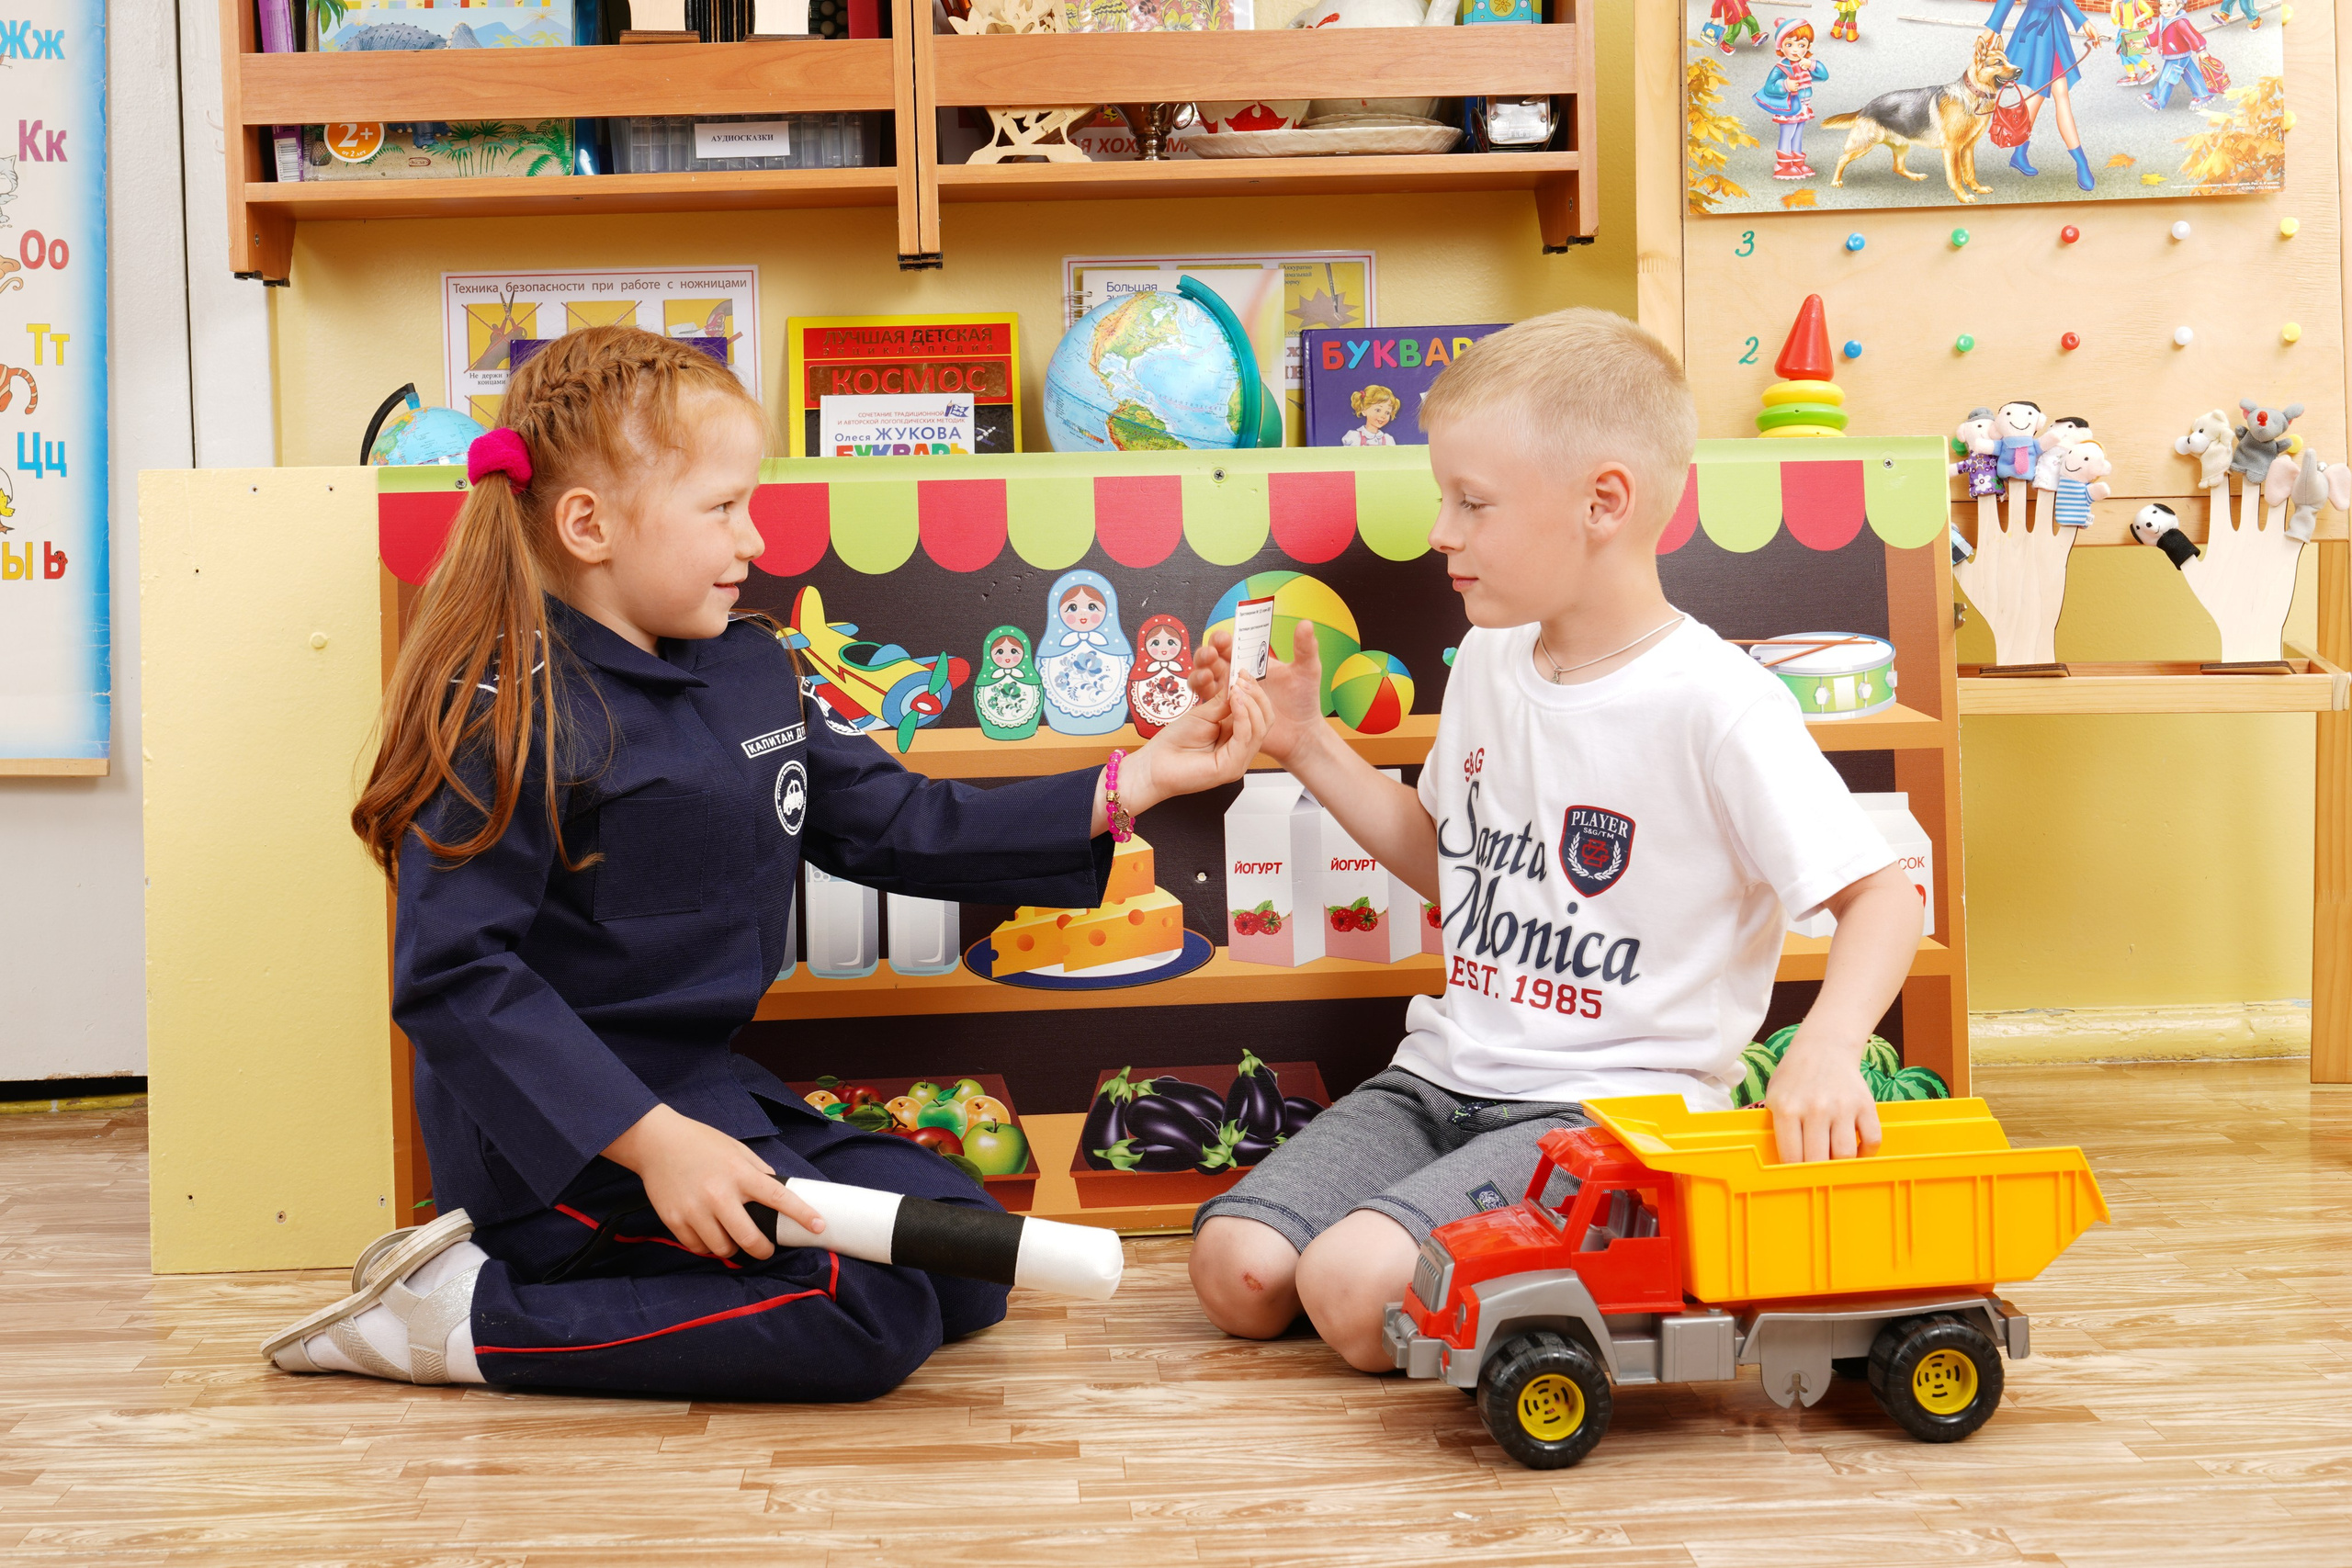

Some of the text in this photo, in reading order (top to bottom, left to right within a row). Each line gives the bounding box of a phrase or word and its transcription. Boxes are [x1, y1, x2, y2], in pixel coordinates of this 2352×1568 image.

[0, 20, 65, 60] Жж
[18, 119, 68, 162] Кк
[337, 123, 374, 148] 2+
[711, 134, 774, 142] АУДИОСКАЗКИ
[19, 229, 70, 270] Оо
[1735, 230, 1755, 257] 3
[453, 279, 747, 293] Техника безопасности при работе с ножницами
[1106, 281, 1158, 292] Большая
[26, 323, 71, 366] Тт
[823, 327, 992, 345] ЛУЧШАЯ ДЕТСКАЯ
[823, 344, 993, 355] ЭНЦИКЛОПЕДИЯ
[1322, 337, 1482, 370] БУКВАР
[1737, 335, 1759, 366] 2
[831, 367, 987, 395] КОСМОС
[834, 426, 962, 442] Олеся ЖУКОВА
[17, 432, 67, 479] Цц
[747, 730, 795, 754] КАПИТАН
[1464, 747, 1485, 783] S&G
[1438, 780, 1547, 882] Santa
[1571, 811, 1629, 839] PLAYER
[1583, 827, 1614, 840] S&G/TM
[1234, 860, 1283, 874] ЙОГУРТ
[1330, 857, 1376, 871] ЙОГУРТ
[1897, 856, 1926, 870] СОК
[1442, 865, 1641, 986] Monica
[1449, 954, 1602, 1020] EST. 1985
